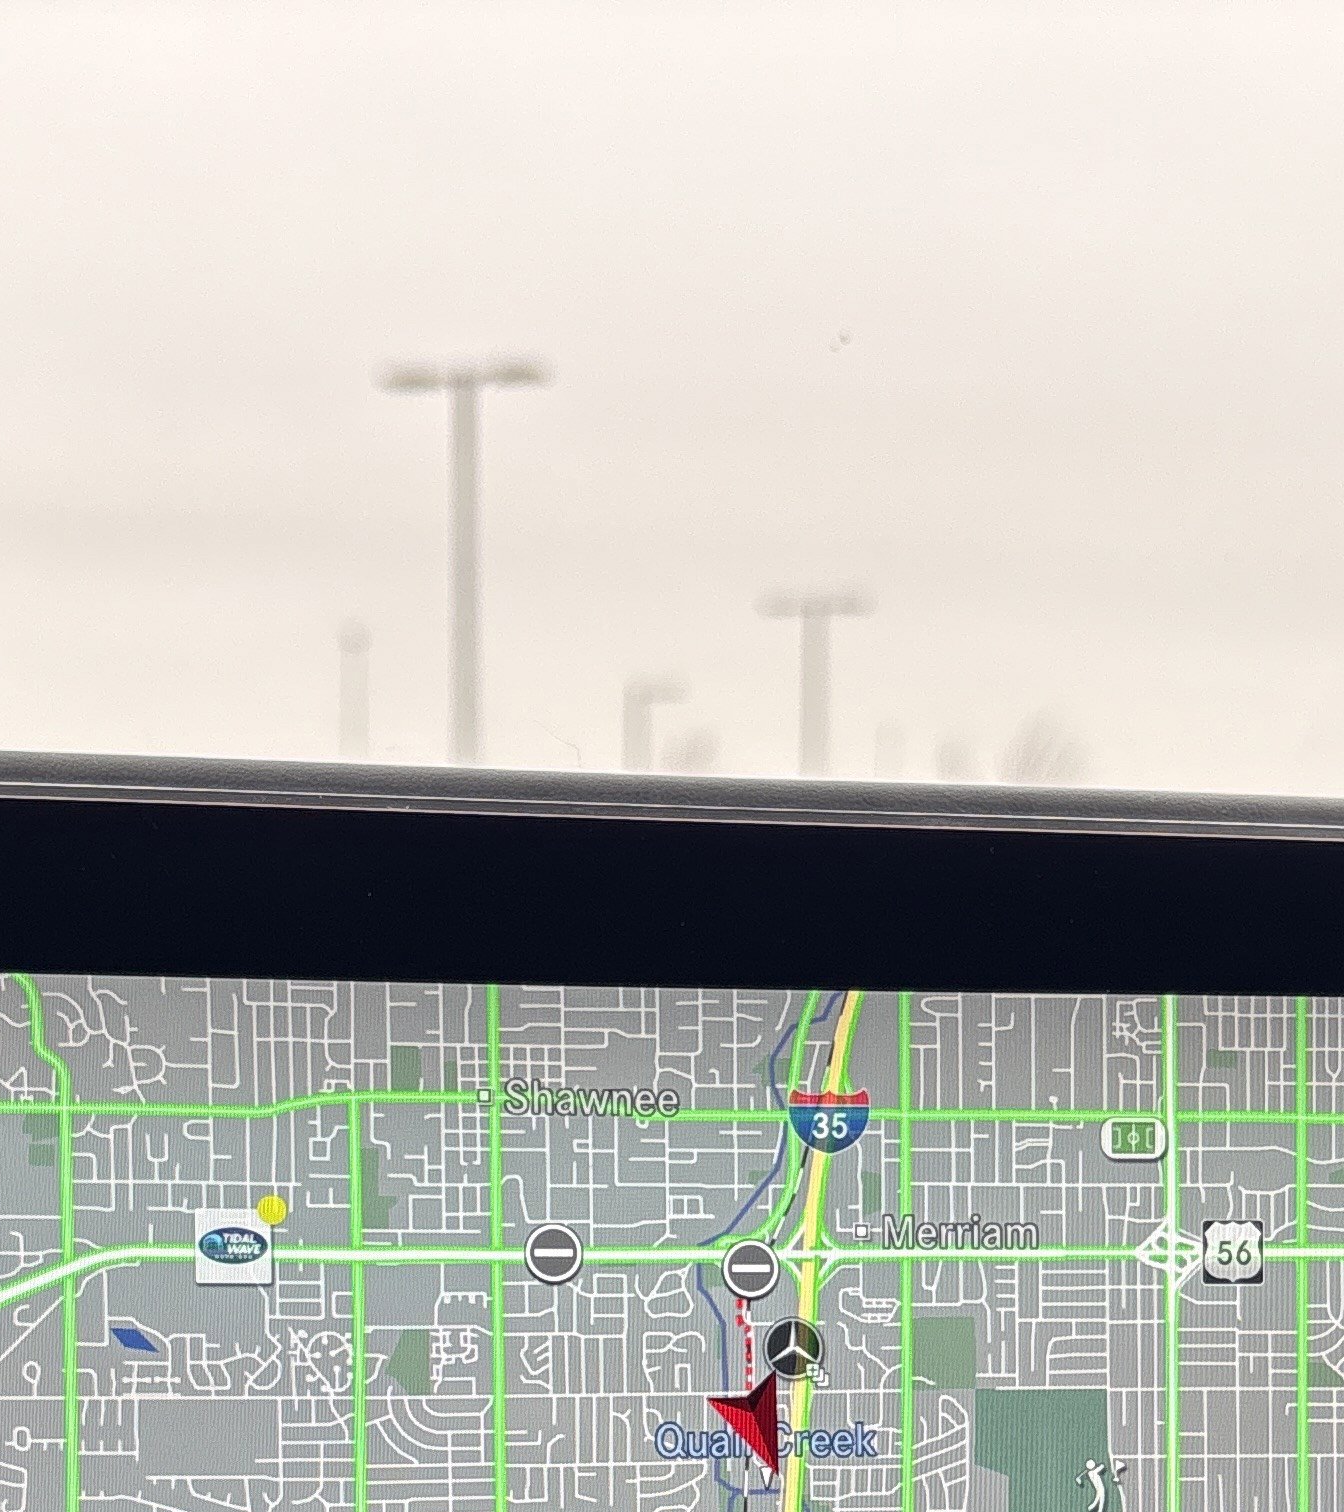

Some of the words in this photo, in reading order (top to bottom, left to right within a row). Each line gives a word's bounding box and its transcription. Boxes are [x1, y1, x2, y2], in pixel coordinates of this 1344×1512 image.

[504, 1078, 680, 1117] Shawnee
[811, 1112, 849, 1140] 35
[222, 1232, 258, 1244] TIDAL
[881, 1214, 1039, 1251] Merriam
[227, 1243, 262, 1255] WAVE
[1216, 1239, 1253, 1267] 56
